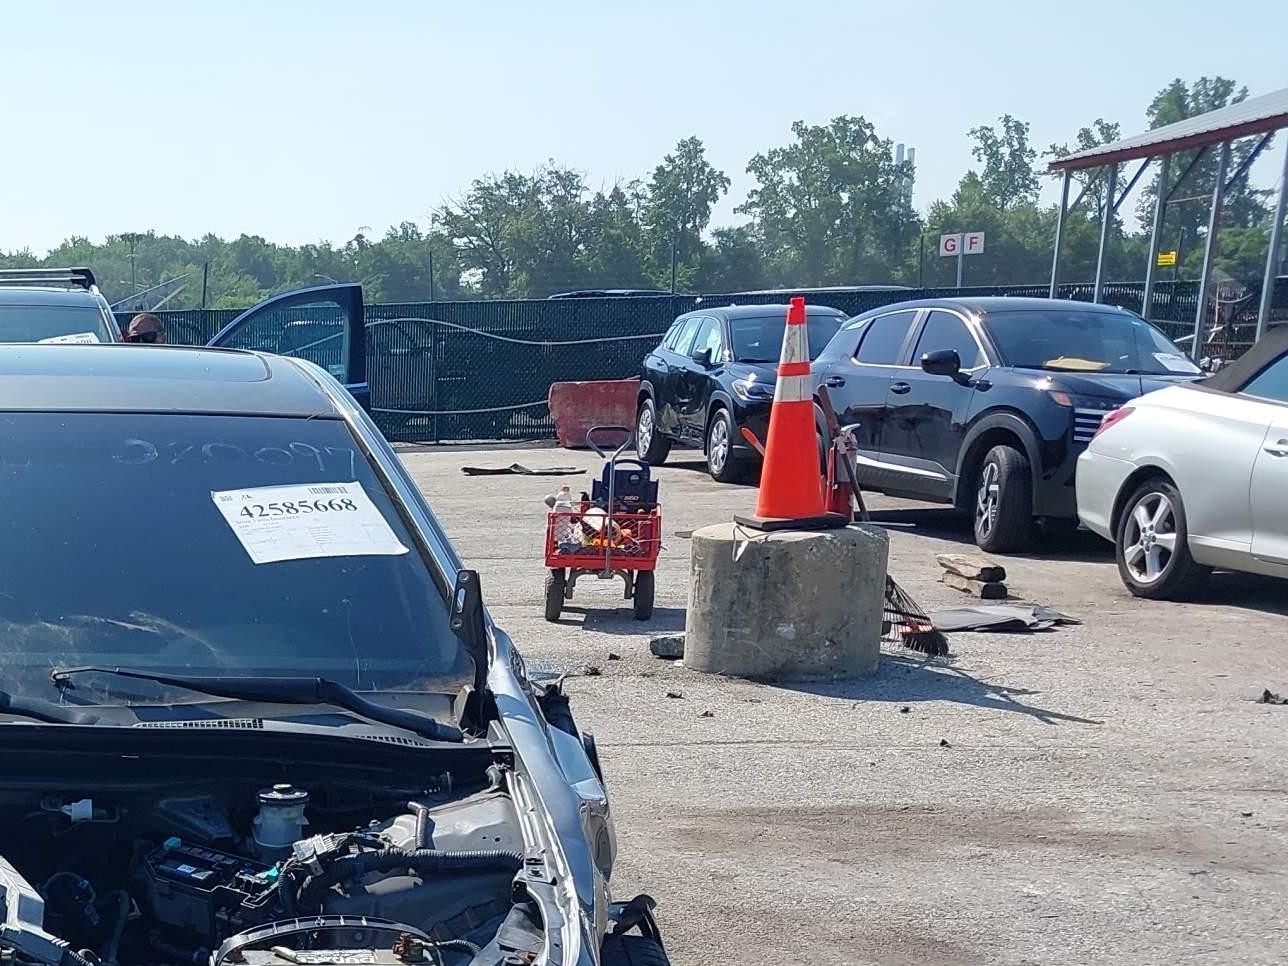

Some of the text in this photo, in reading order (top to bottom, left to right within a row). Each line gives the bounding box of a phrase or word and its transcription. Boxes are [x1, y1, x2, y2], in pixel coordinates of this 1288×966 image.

[944, 238, 956, 252] G
[969, 236, 979, 251] F
[239, 498, 358, 519] 42585668
